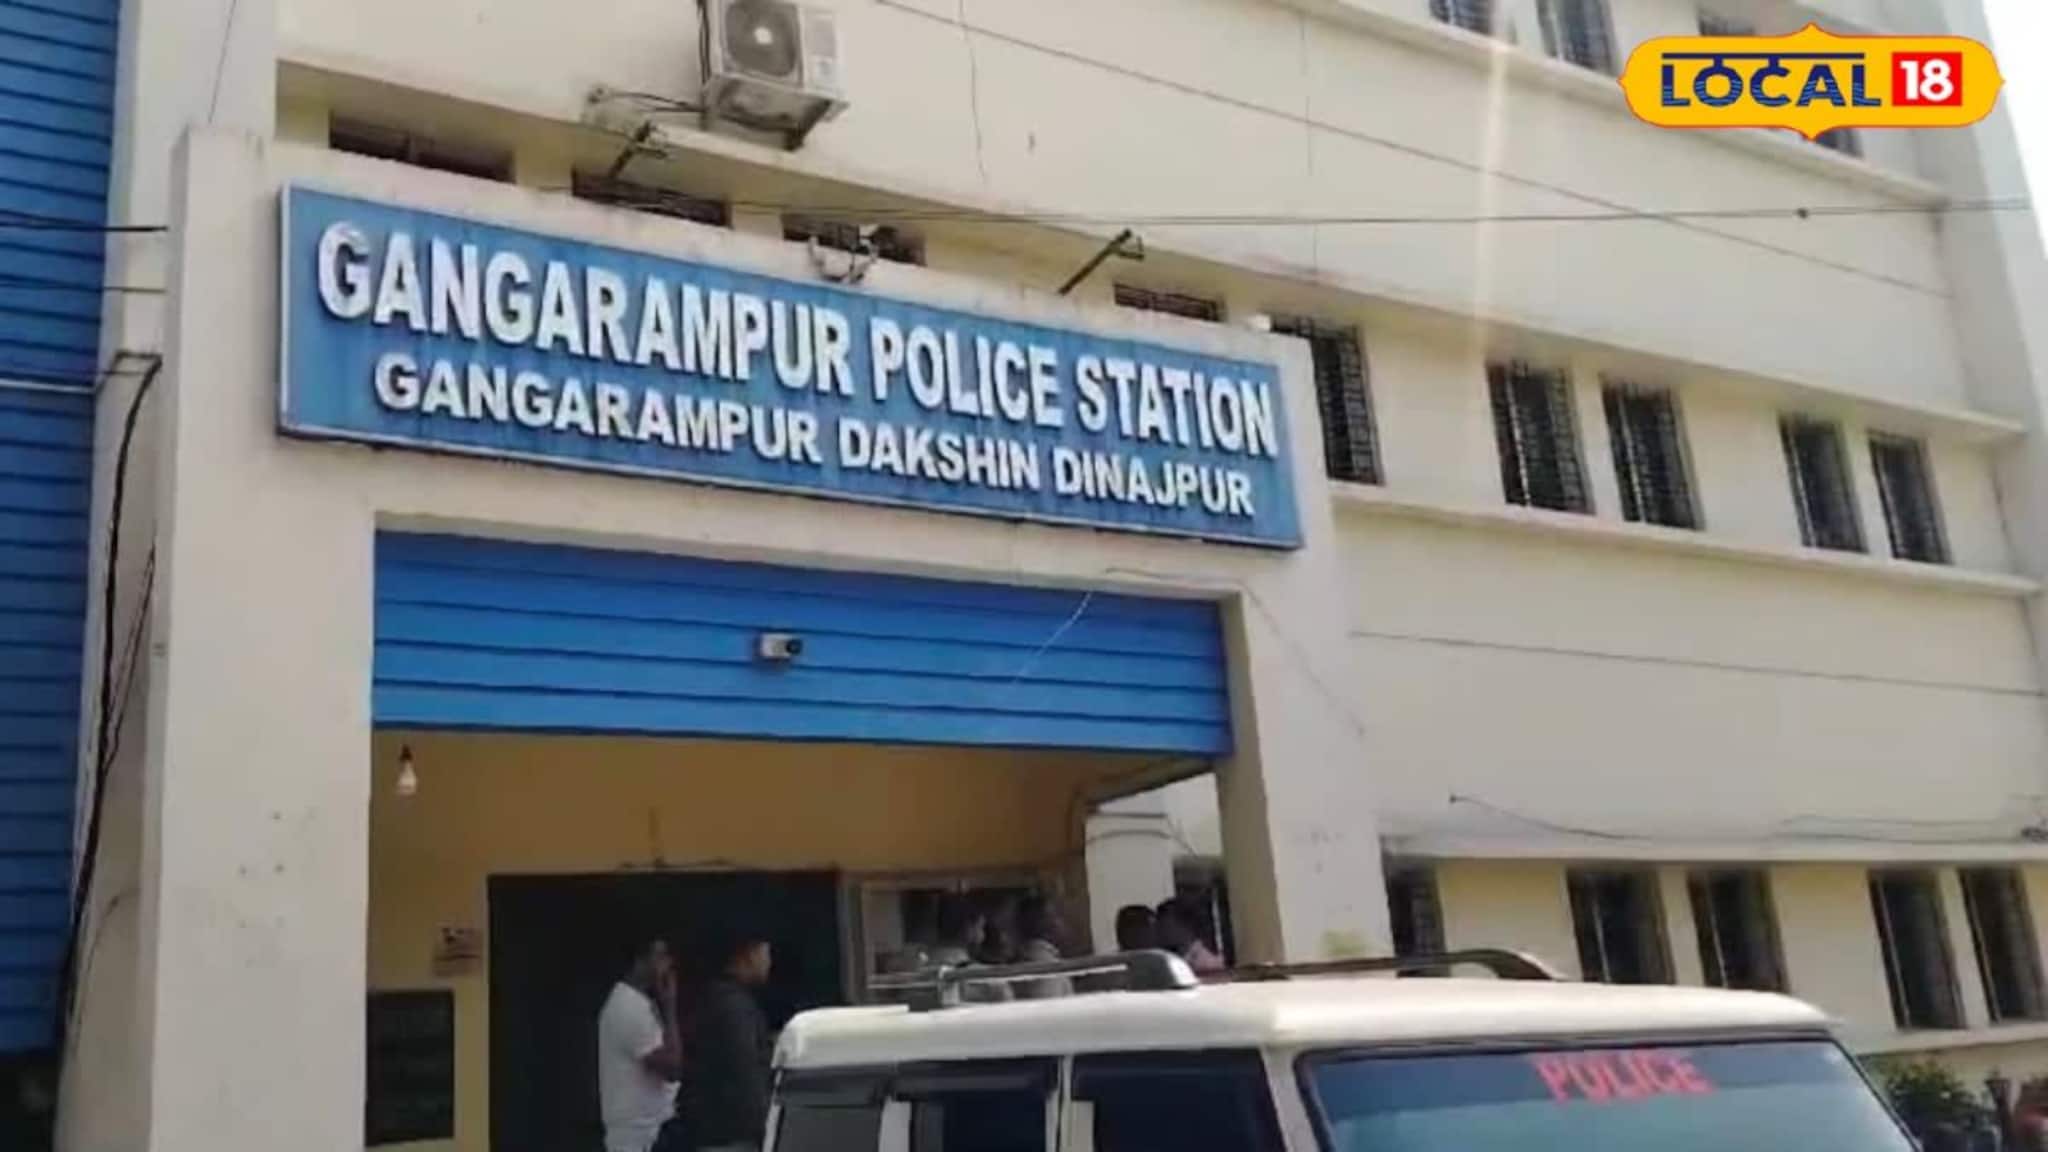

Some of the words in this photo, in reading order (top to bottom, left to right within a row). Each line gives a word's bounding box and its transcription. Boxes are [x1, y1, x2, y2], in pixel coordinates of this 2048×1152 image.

[318, 220, 854, 395] GANGARAMPUR
[871, 318, 1064, 428] POLICE
[1076, 354, 1278, 458] STATION
[375, 353, 823, 465] GANGARAMPUR
[839, 419, 1040, 491] DAKSHIN
[1054, 448, 1254, 516] DINAJPUR
[1535, 1052, 1713, 1104] POLICE
